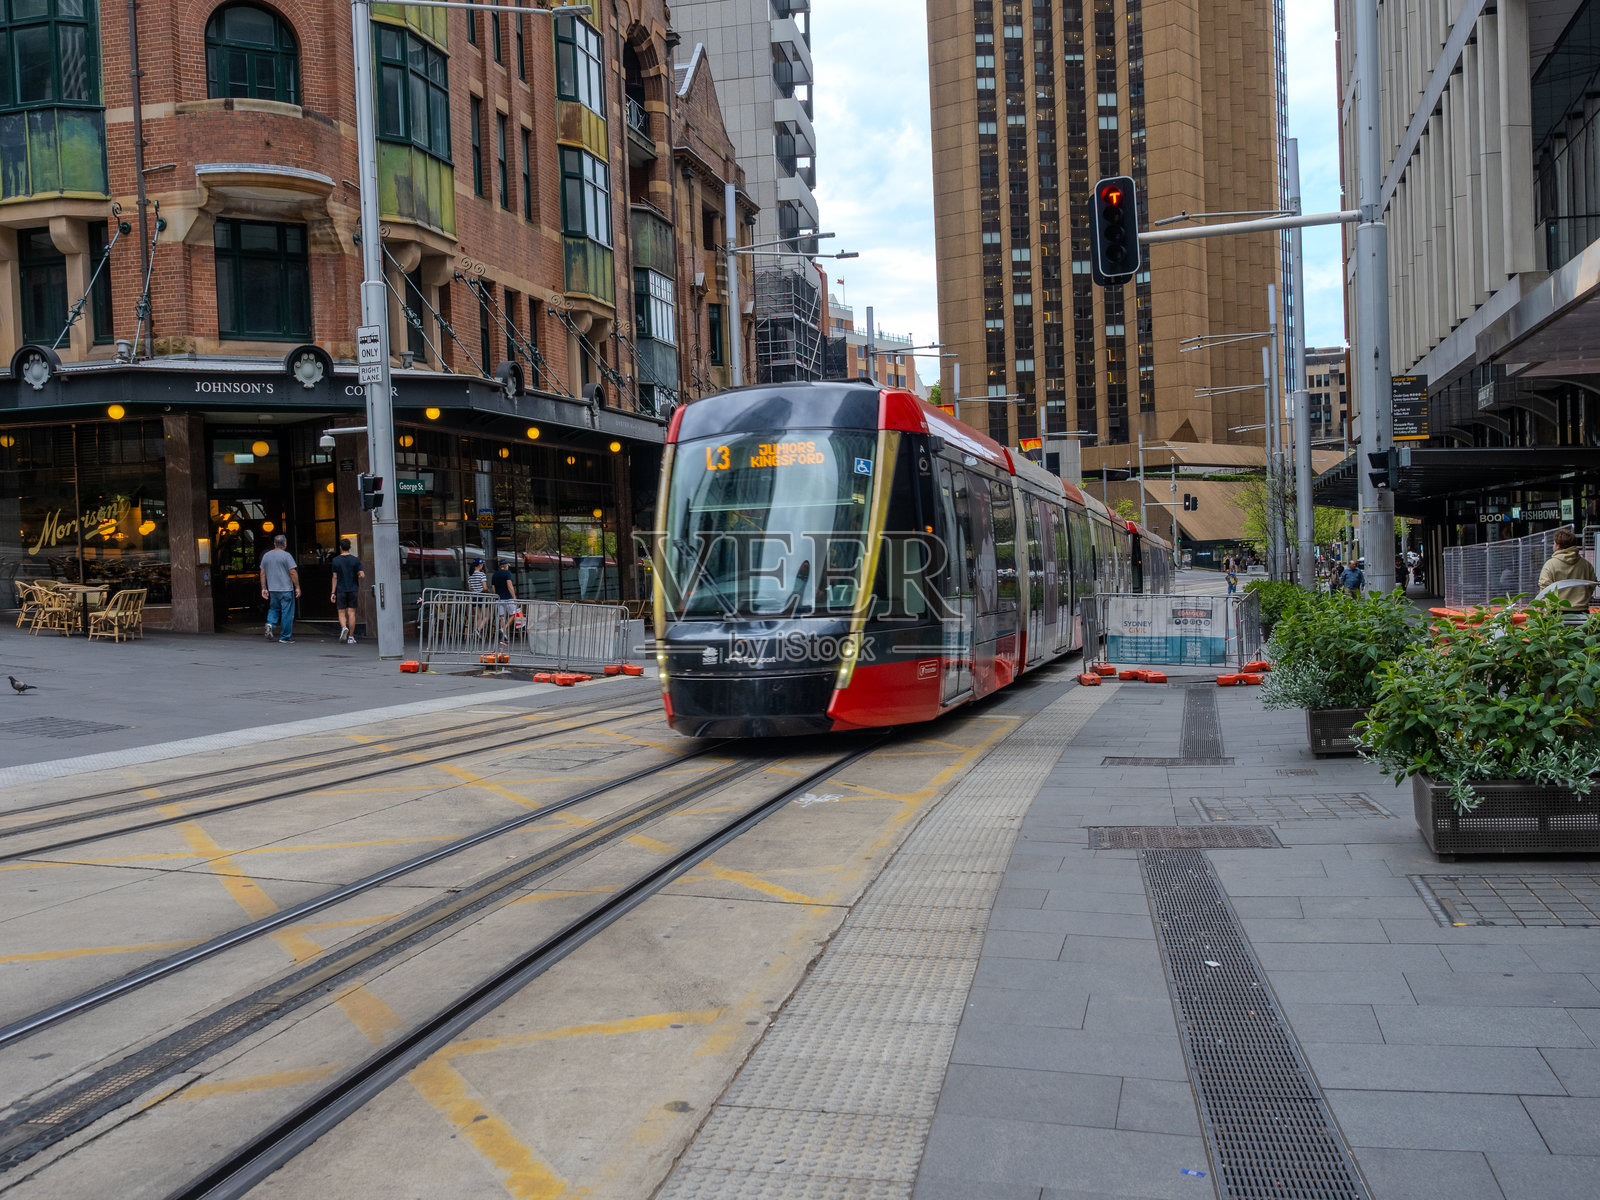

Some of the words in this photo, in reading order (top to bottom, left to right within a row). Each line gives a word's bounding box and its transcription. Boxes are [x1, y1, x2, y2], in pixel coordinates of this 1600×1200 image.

[361, 348, 379, 358] ONLY
[361, 366, 380, 374] RIGHT
[362, 374, 380, 382] LANE
[194, 381, 274, 394] JOHNSON'S
[344, 385, 399, 397] COR
[706, 445, 731, 471] L3
[758, 441, 816, 456] JUNIORS
[750, 452, 825, 468] KINGSFORD
[399, 481, 417, 493] George
[417, 482, 424, 491] St
[1480, 513, 1502, 523] BOQ
[1521, 509, 1561, 521] FISHBOWL
